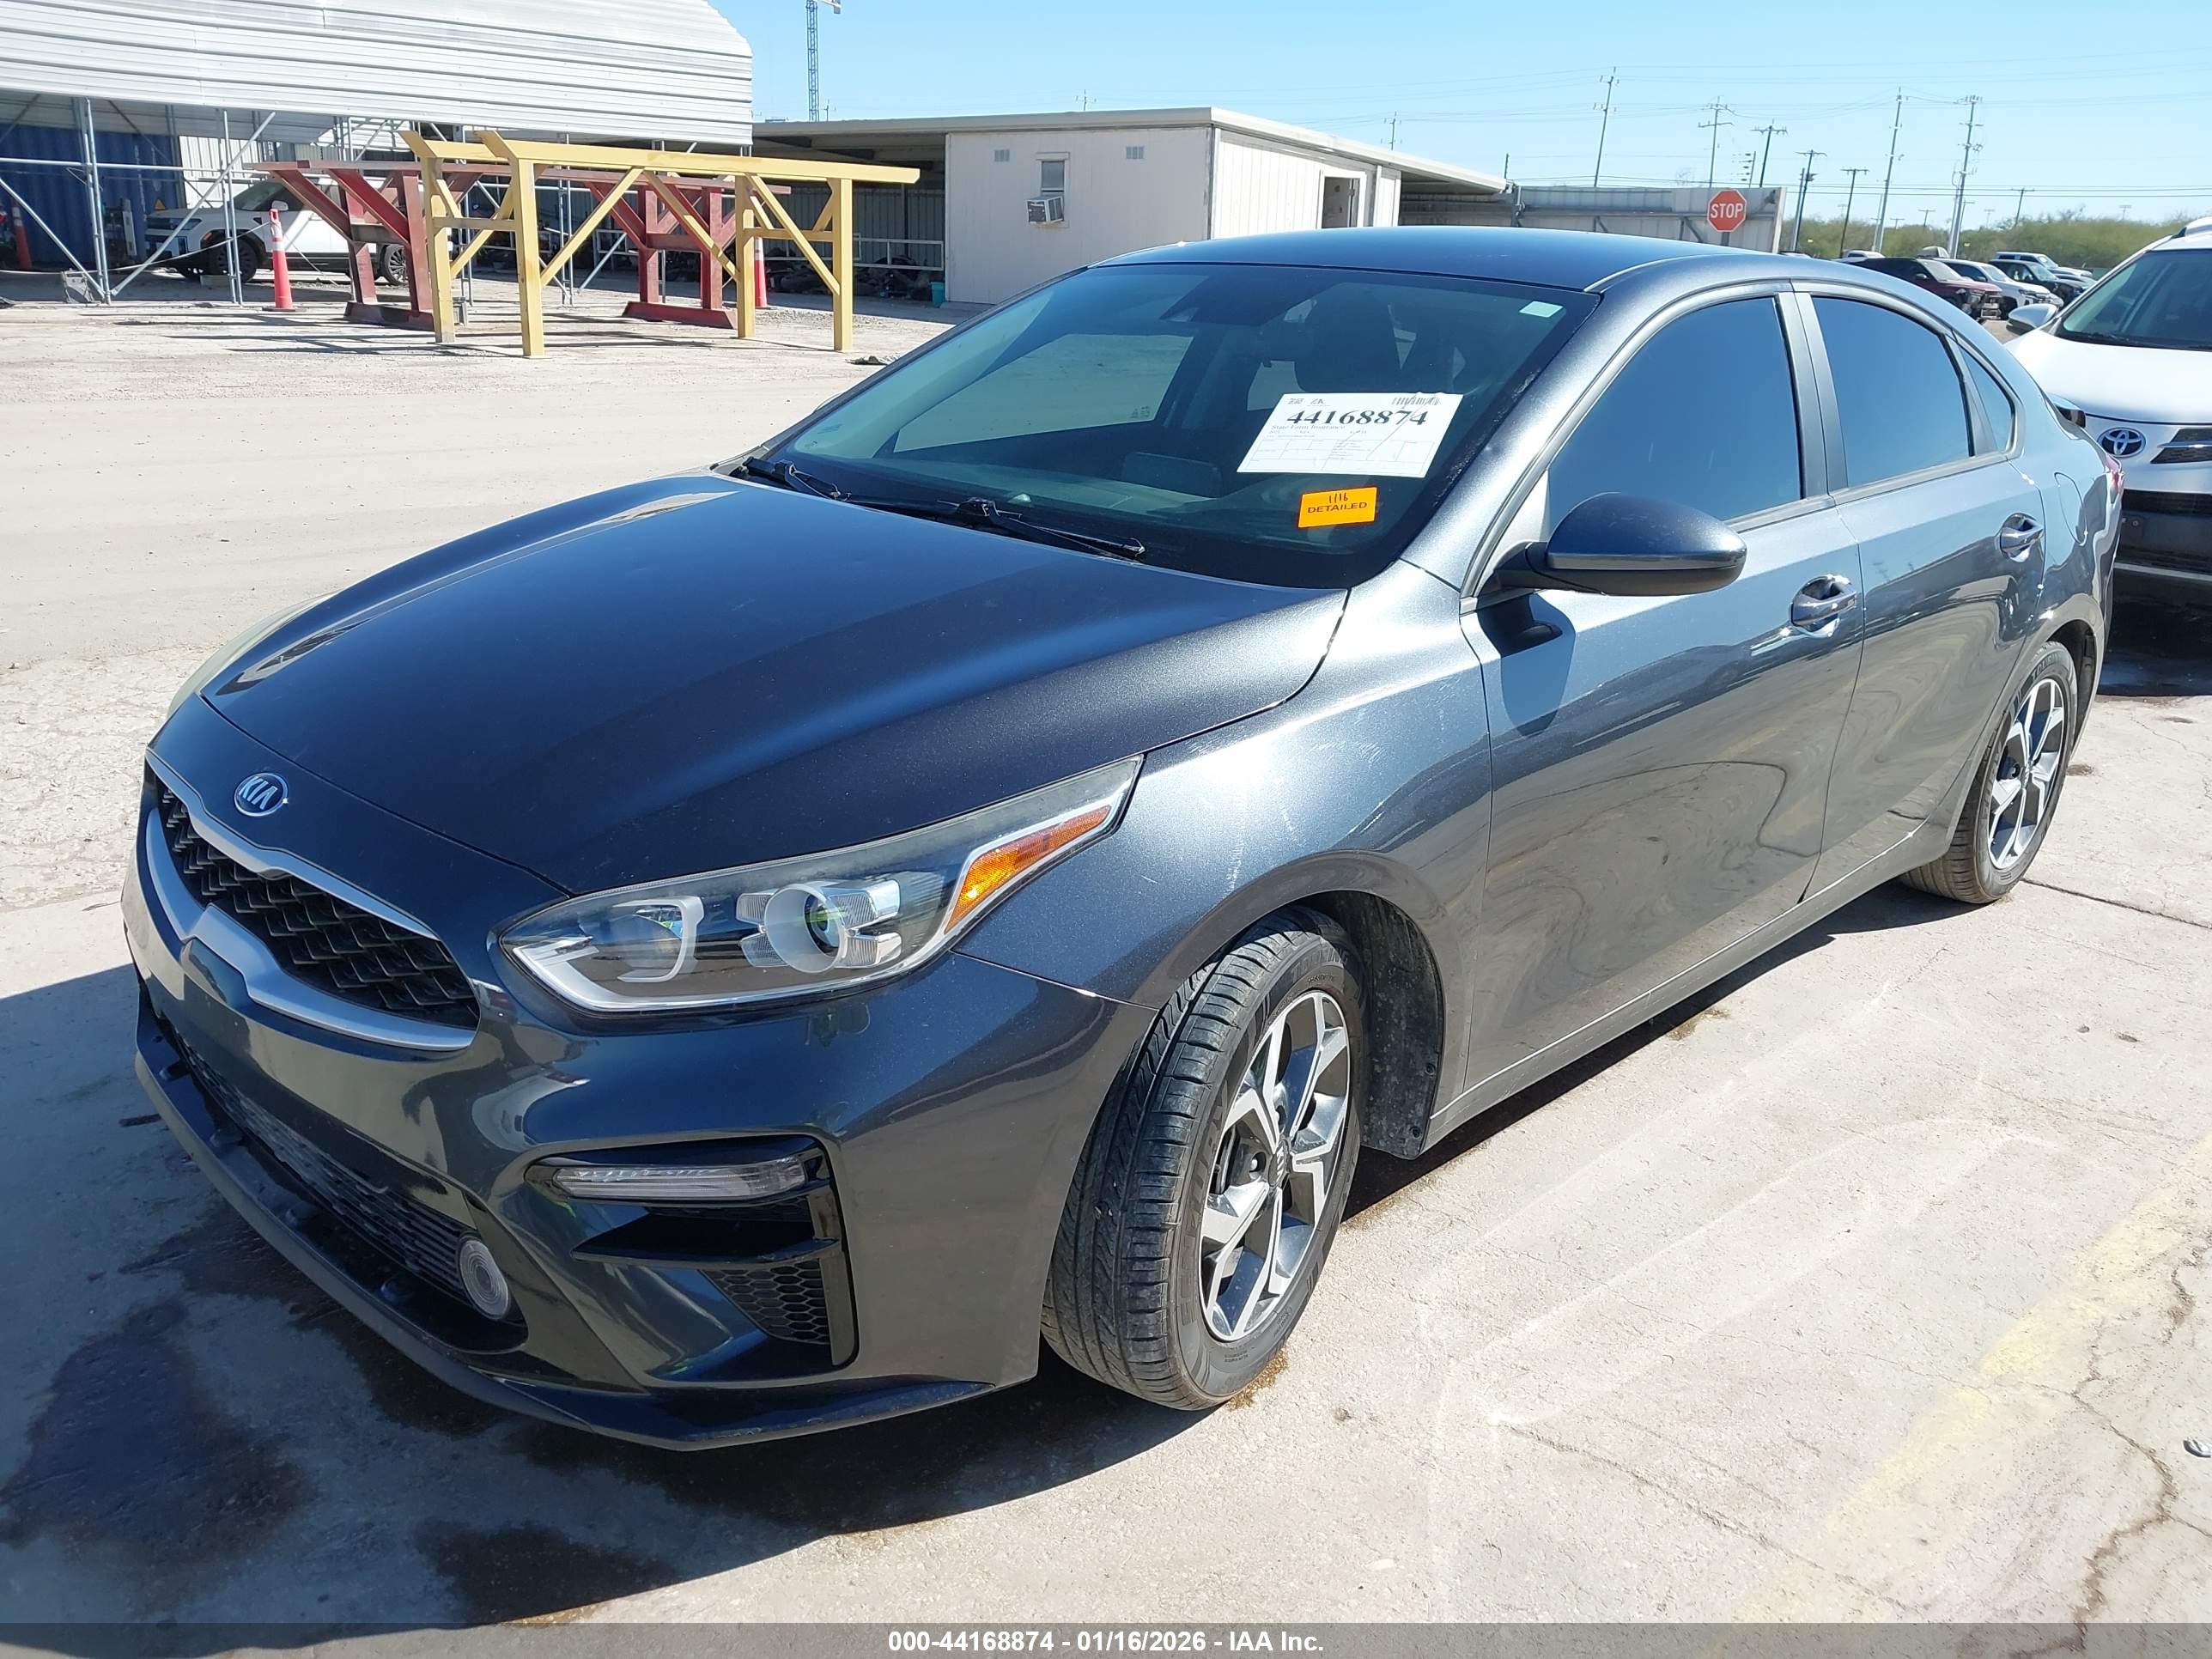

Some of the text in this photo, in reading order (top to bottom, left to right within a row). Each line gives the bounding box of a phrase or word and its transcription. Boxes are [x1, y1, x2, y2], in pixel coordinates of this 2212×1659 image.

[1710, 203, 1744, 219] STOP
[1287, 410, 1429, 426] 44168874
[1308, 501, 1368, 514] DETAILED
[239, 775, 278, 810] KIA
